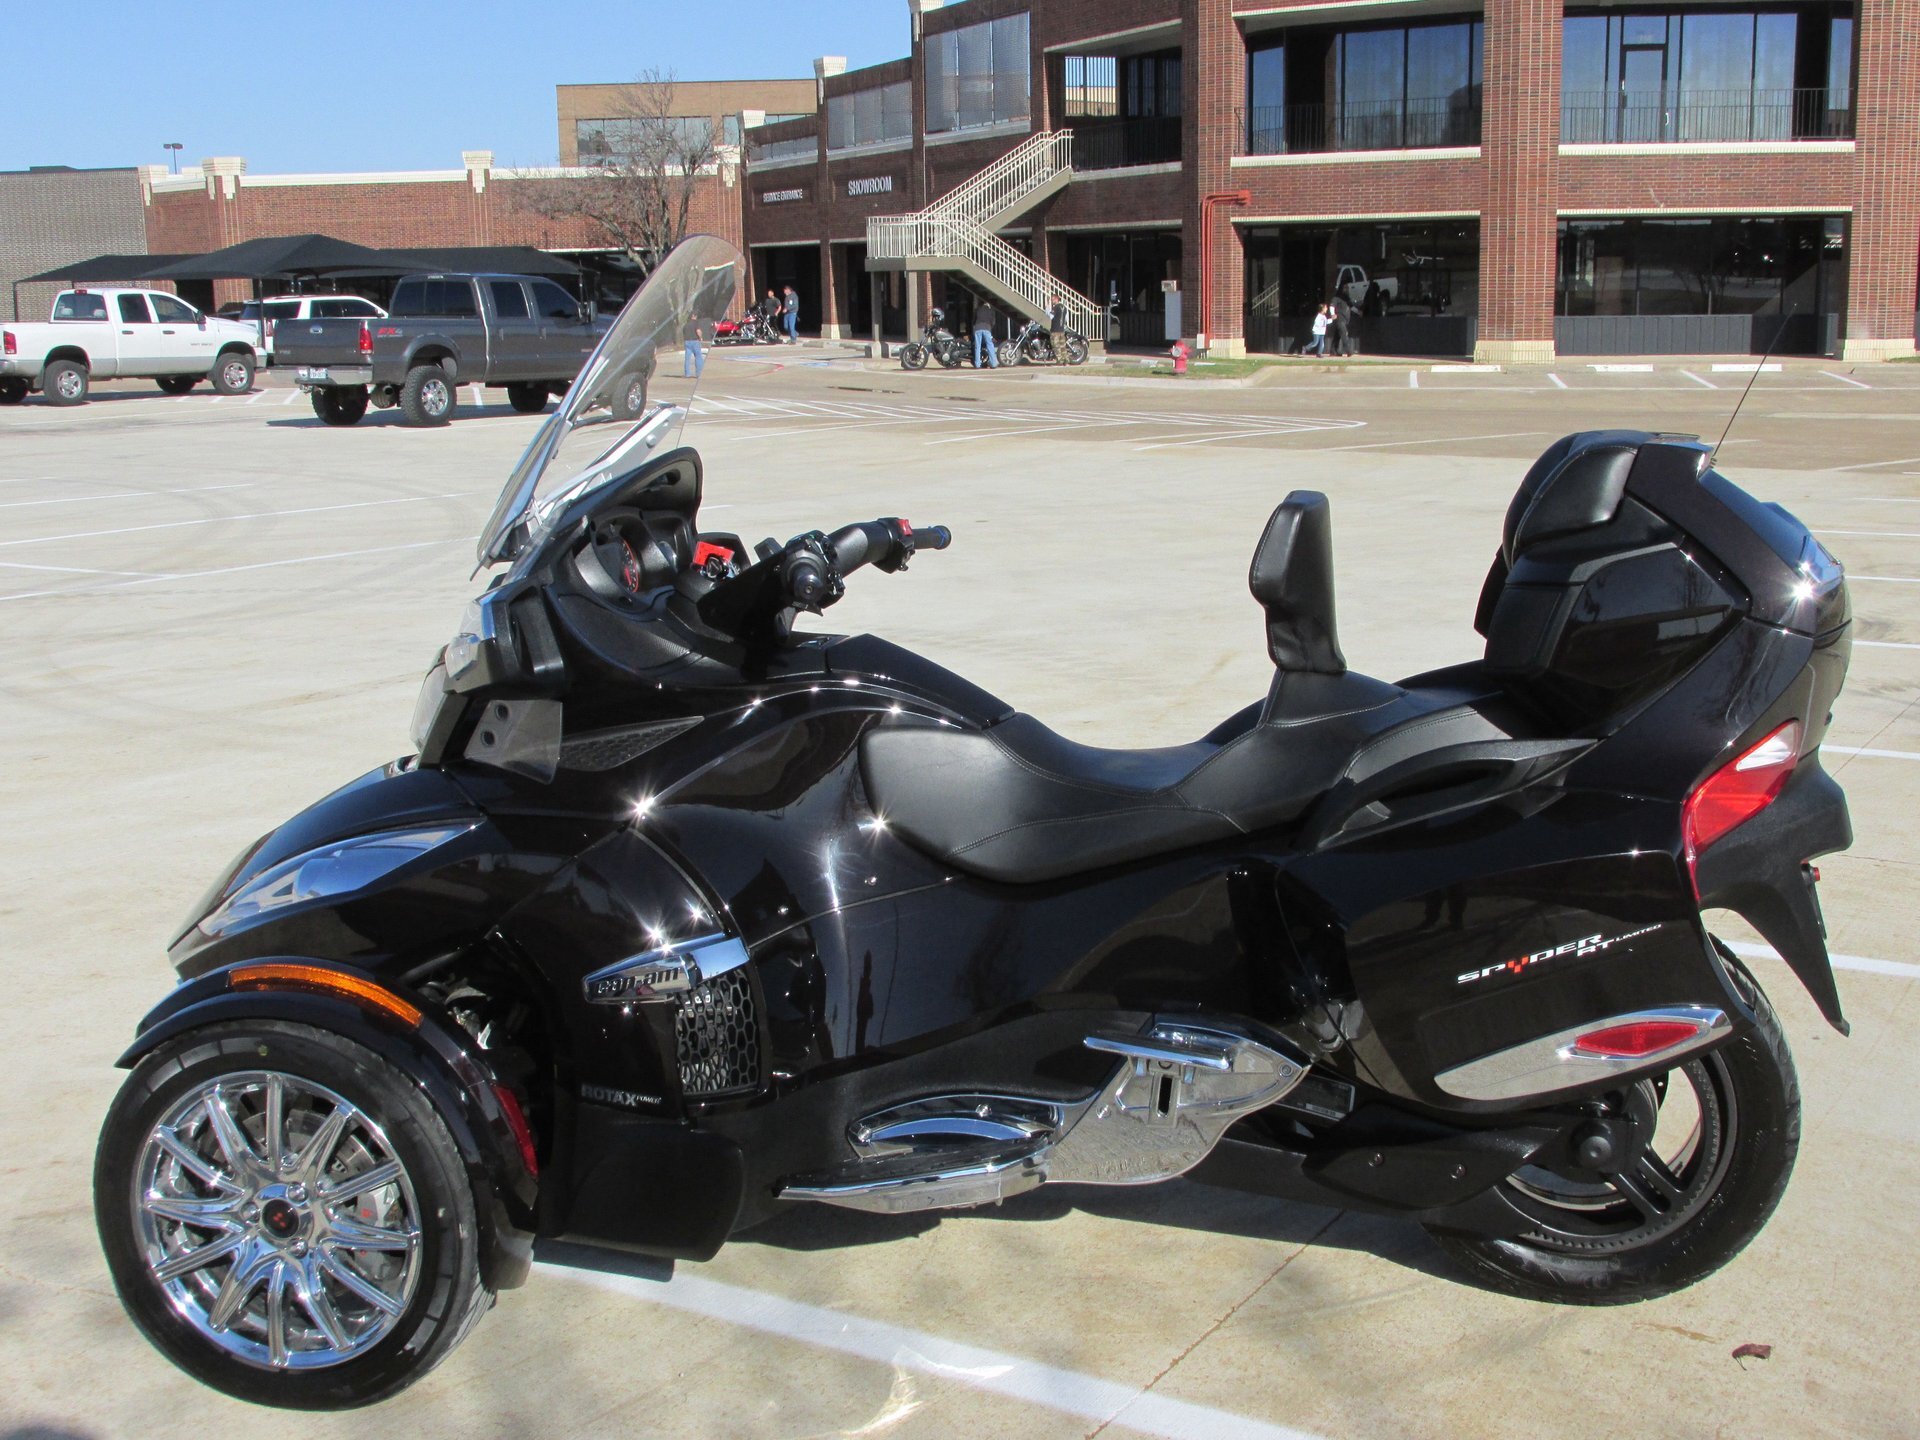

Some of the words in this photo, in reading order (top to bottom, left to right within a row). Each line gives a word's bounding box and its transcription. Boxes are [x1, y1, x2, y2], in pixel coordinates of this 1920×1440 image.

[763, 191, 780, 203] SERVICE
[780, 188, 803, 201] ENTRANCE
[848, 176, 892, 196] SHOWROOM
[1576, 938, 1615, 957] RT
[1615, 923, 1662, 942] LIMITED
[1457, 933, 1603, 984] SPYDER
[581, 1083, 636, 1107] ROTAX
